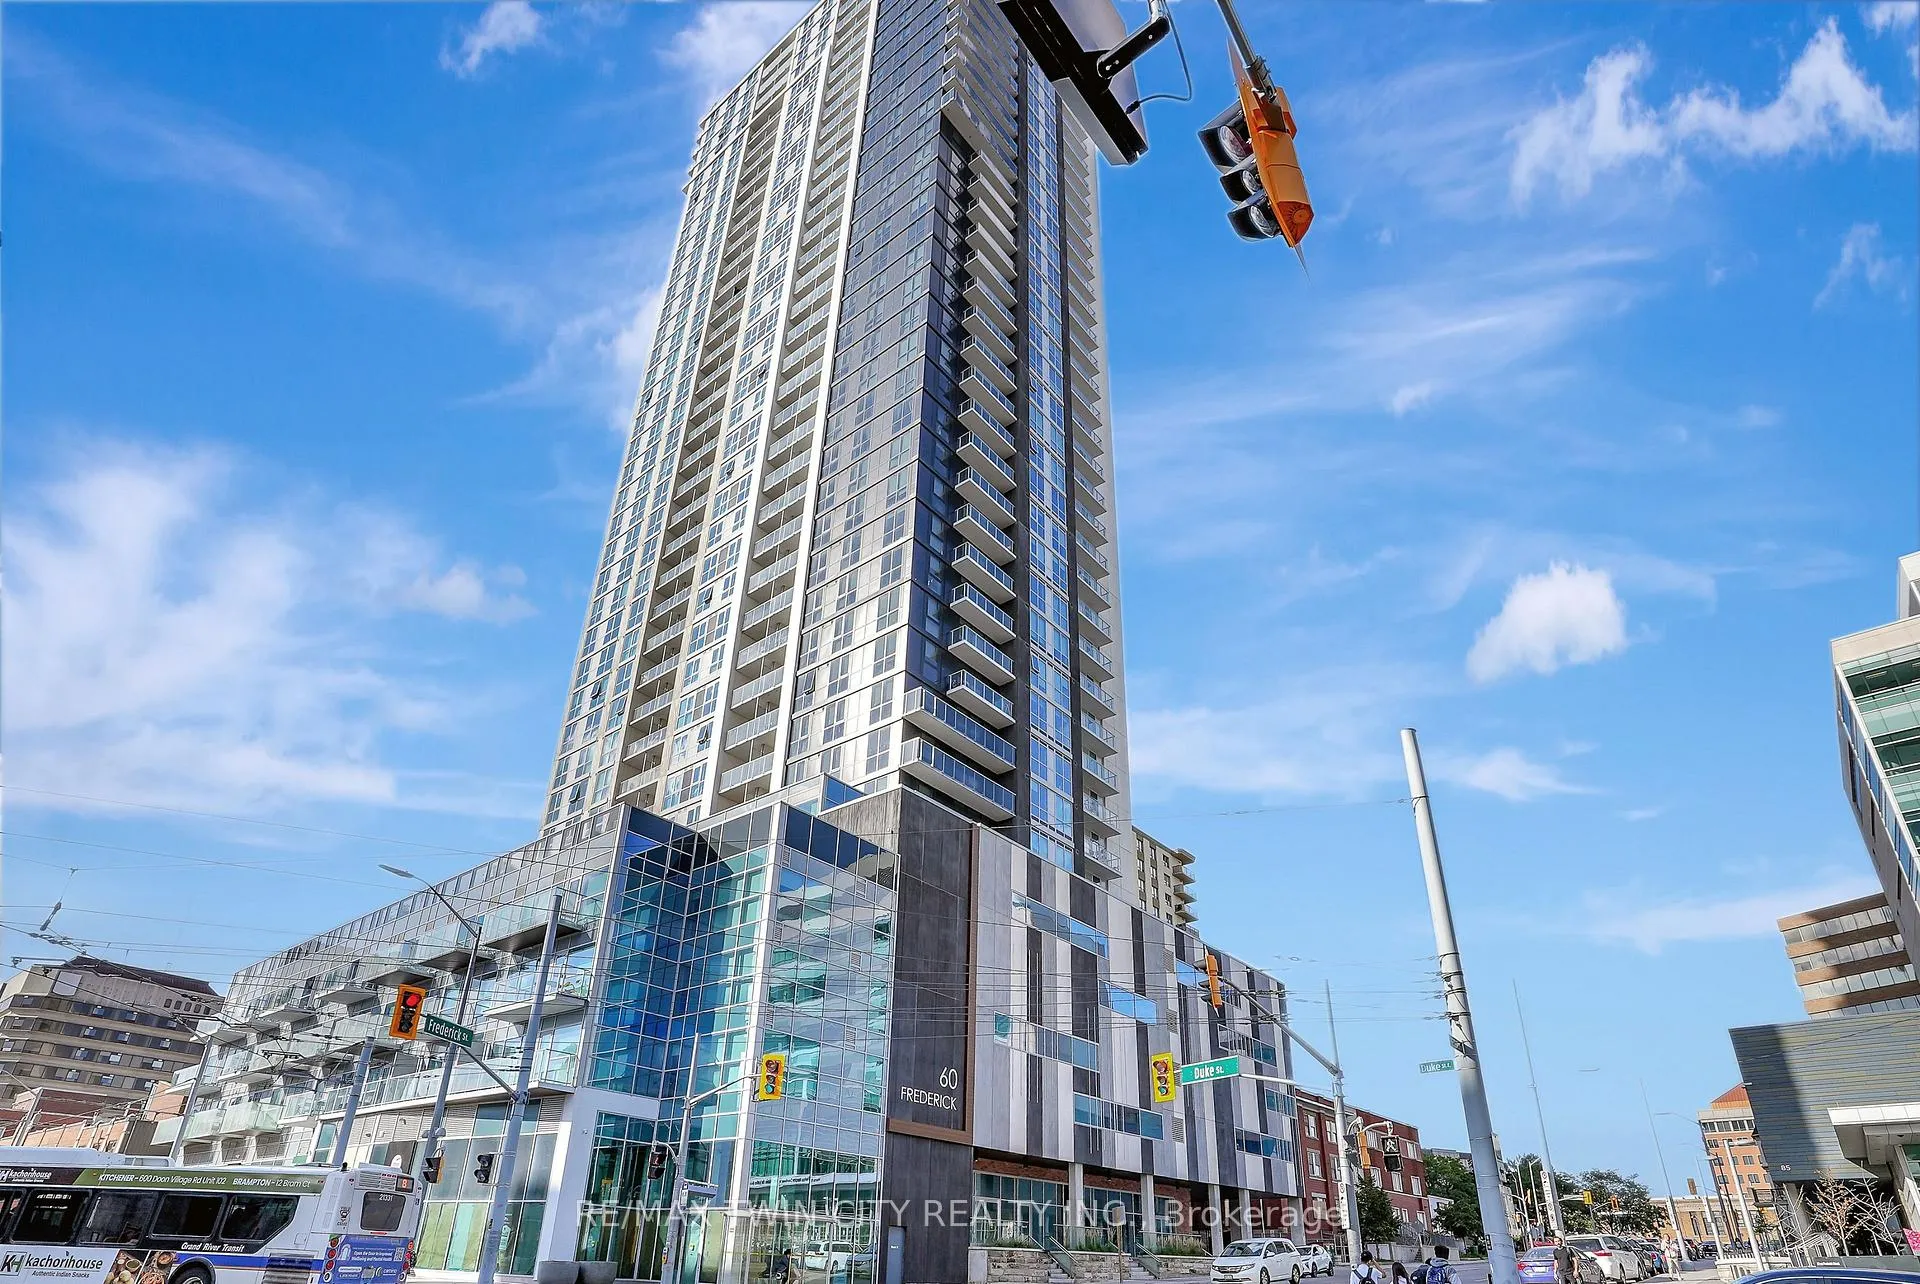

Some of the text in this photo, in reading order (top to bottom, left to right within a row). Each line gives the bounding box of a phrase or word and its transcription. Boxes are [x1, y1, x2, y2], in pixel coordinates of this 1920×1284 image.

[428, 1020, 461, 1040] Frederick
[1194, 1065, 1216, 1079] Duke
[1421, 1063, 1440, 1072] Duke
[940, 1067, 958, 1089] 60
[900, 1086, 957, 1111] FREDERICK
[98, 1174, 135, 1182] KITCHENER
[139, 1174, 152, 1182] 600
[152, 1175, 169, 1183] Doon
[171, 1176, 192, 1185] Village
[192, 1176, 202, 1184] Rd
[233, 1178, 271, 1186] BRAMPTON
[401, 1179, 408, 1188] 8
[181, 1242, 245, 1252] Grand River Transit
[25, 1252, 103, 1269] kachorihouse
